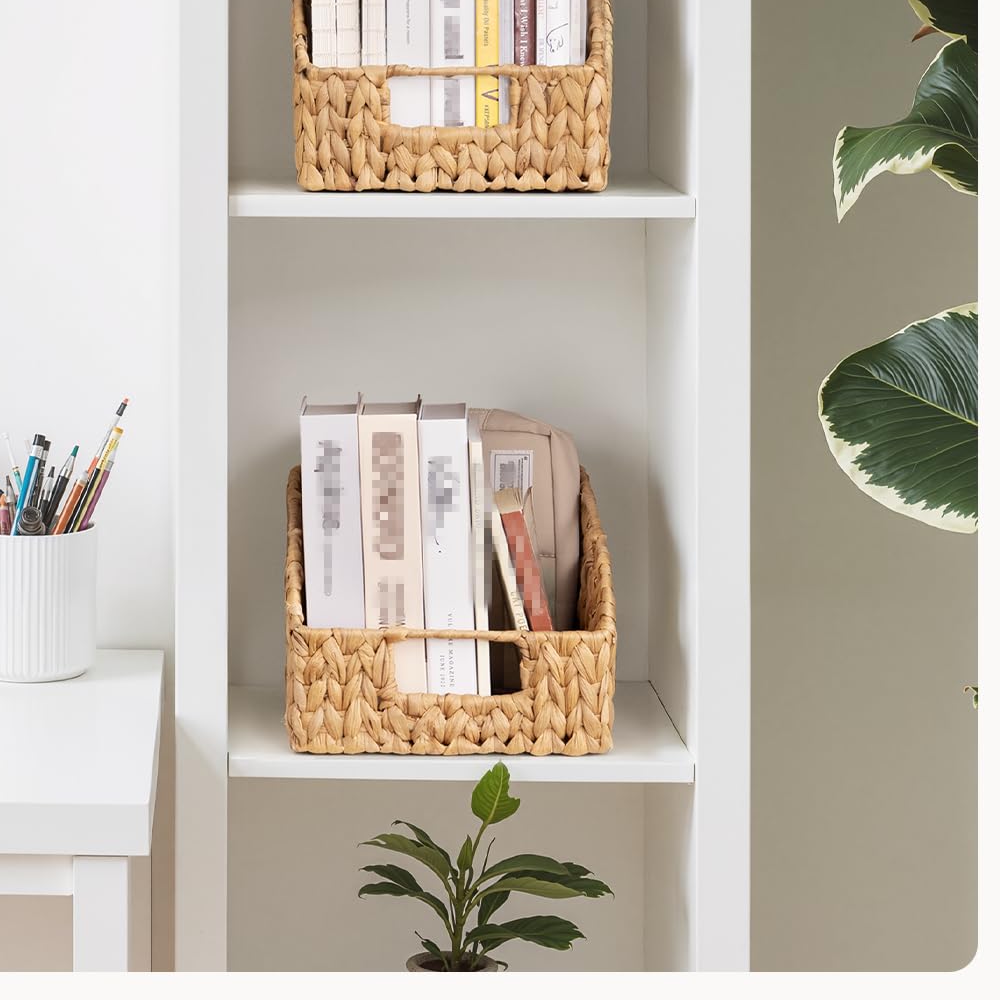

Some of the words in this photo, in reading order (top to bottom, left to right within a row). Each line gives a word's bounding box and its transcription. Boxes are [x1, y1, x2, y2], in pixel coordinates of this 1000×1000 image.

[520, 13, 529, 37] Wish
[520, 44, 529, 67] Knew
[448, 649, 456, 688] MAGAZINE
